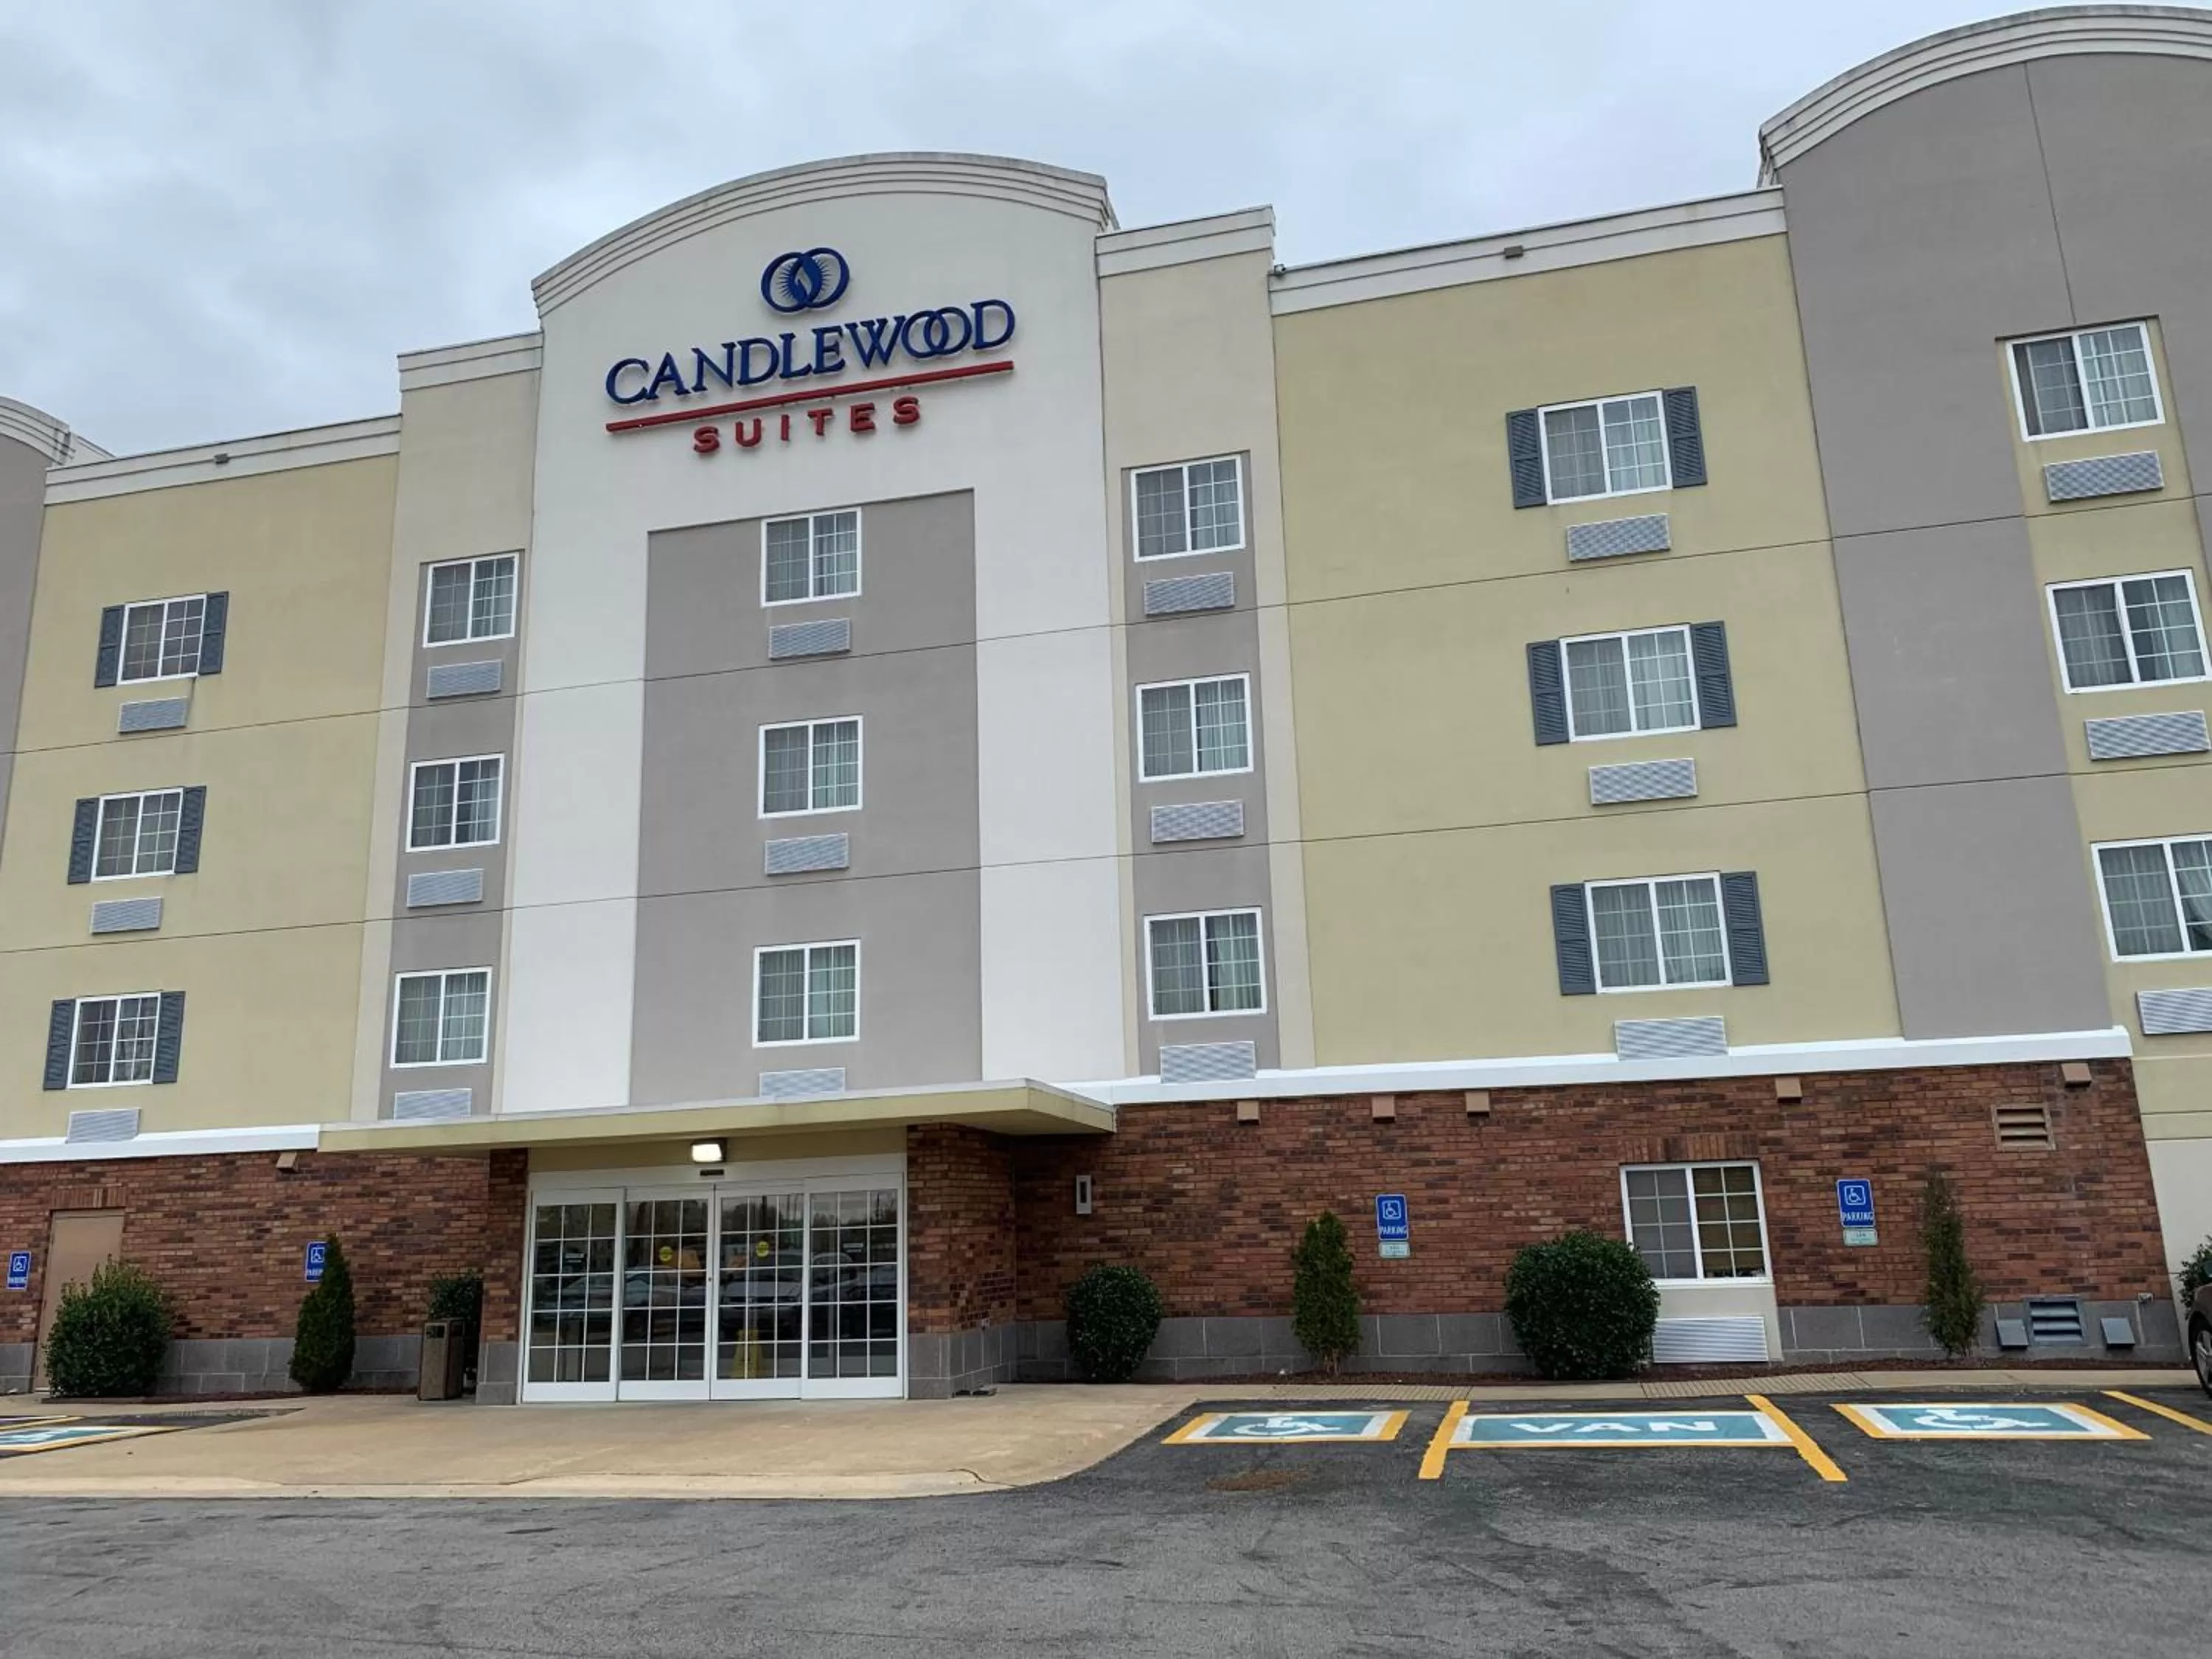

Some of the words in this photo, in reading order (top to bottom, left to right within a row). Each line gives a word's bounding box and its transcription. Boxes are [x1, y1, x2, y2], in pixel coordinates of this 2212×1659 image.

[605, 299, 1015, 405] CANDLEWOOD
[693, 397, 921, 454] SUITES
[1509, 1421, 1719, 1433] VAN
